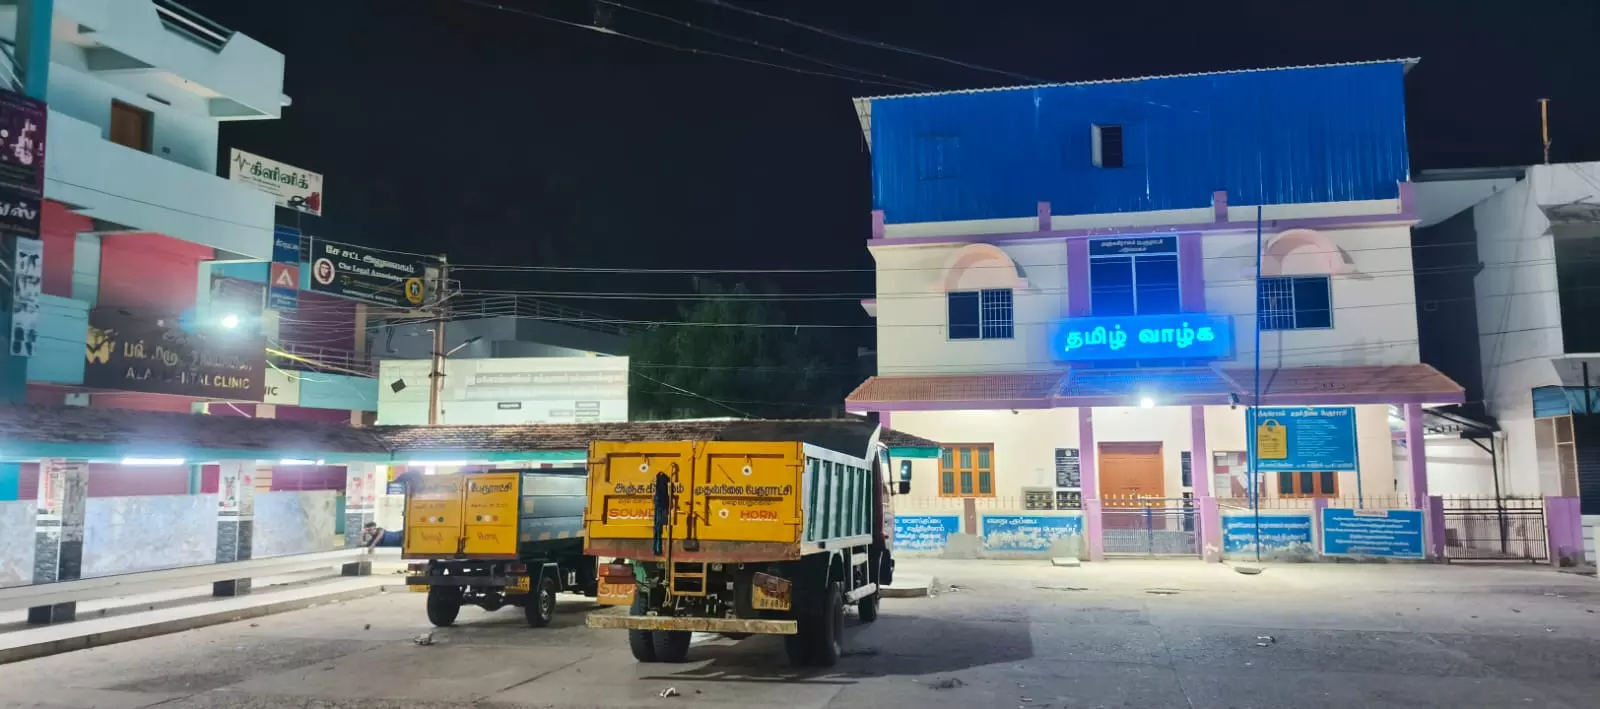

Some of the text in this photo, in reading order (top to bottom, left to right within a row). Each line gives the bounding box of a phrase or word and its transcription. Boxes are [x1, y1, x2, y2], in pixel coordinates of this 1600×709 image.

[250, 160, 309, 190] கிளினிக்
[1065, 322, 1215, 351] தமிழ் வாழ்க
[213, 375, 251, 390] CLINIC
[740, 510, 777, 520] HORN
